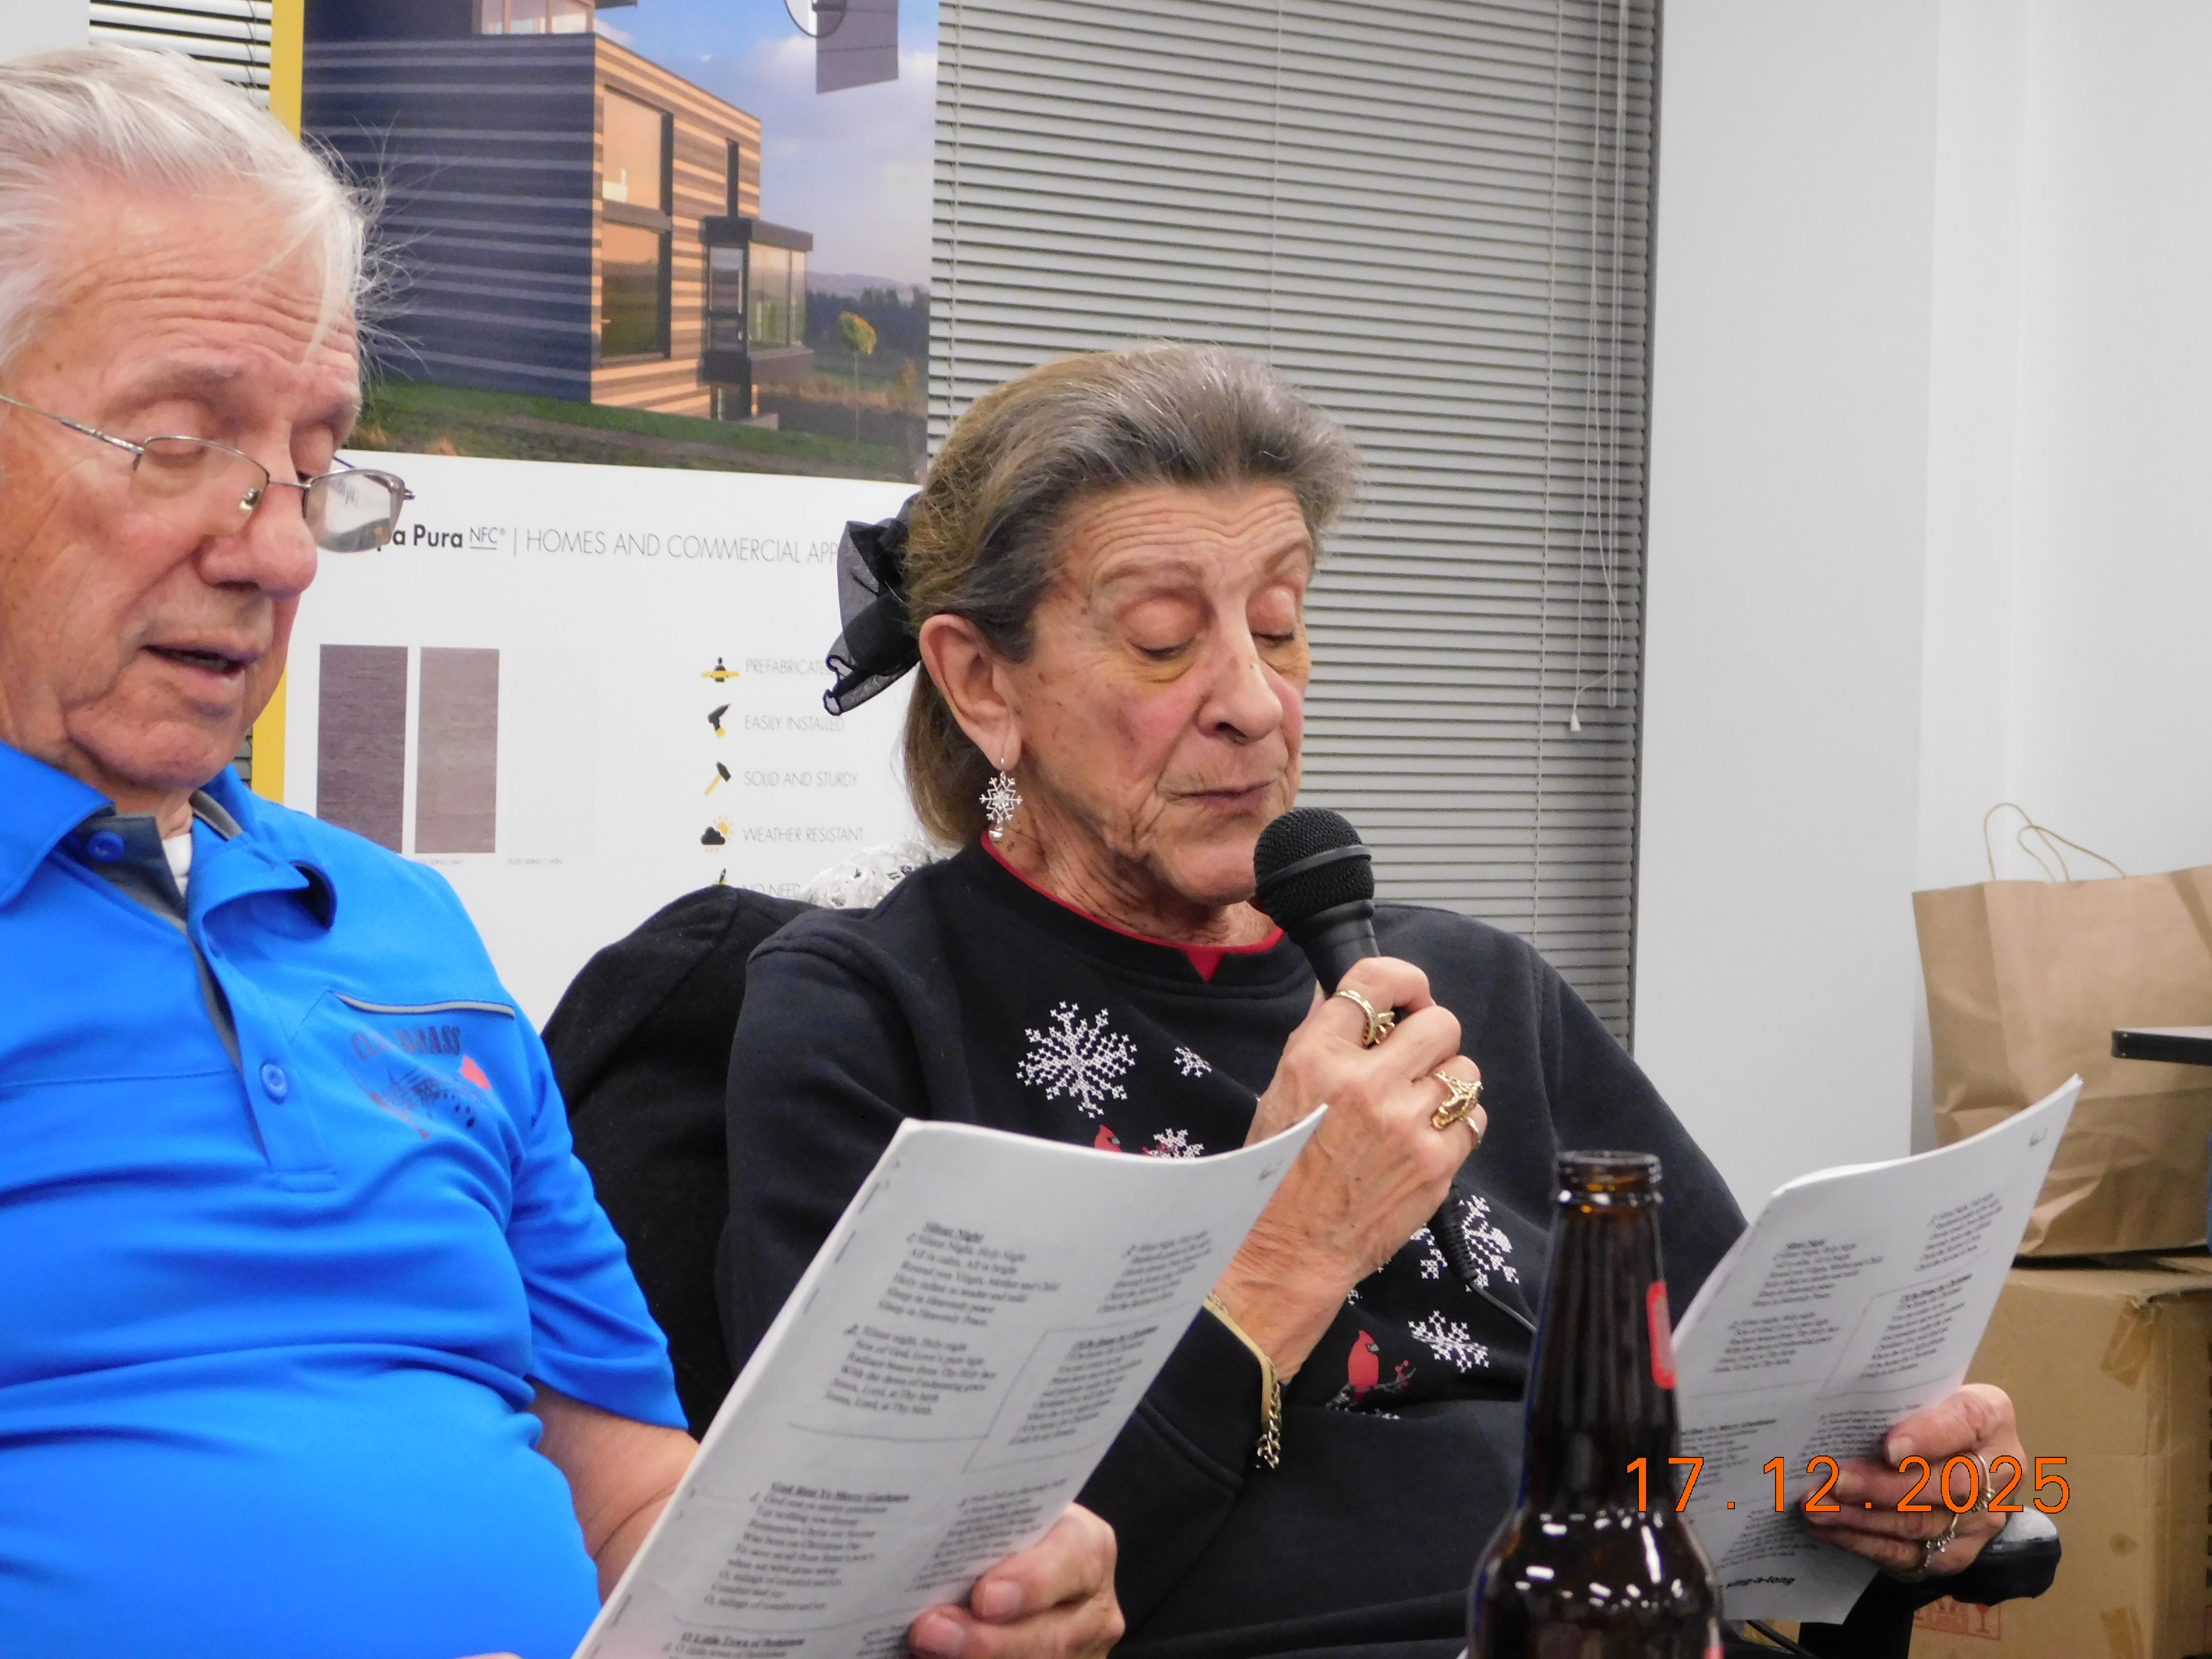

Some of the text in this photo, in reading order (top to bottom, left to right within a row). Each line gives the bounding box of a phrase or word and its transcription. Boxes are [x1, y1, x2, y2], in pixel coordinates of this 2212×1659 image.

[413, 523, 463, 548] Pura
[527, 528, 606, 554] HOMES
[613, 533, 661, 557] AND
[667, 534, 801, 564] COMMERCIAL
[806, 541, 838, 564] APP
[745, 714, 844, 732] EASILY INSTALLED
[744, 770, 859, 787] SOLID AND STURDY
[743, 827, 864, 842] WEATHER RESISTANT
